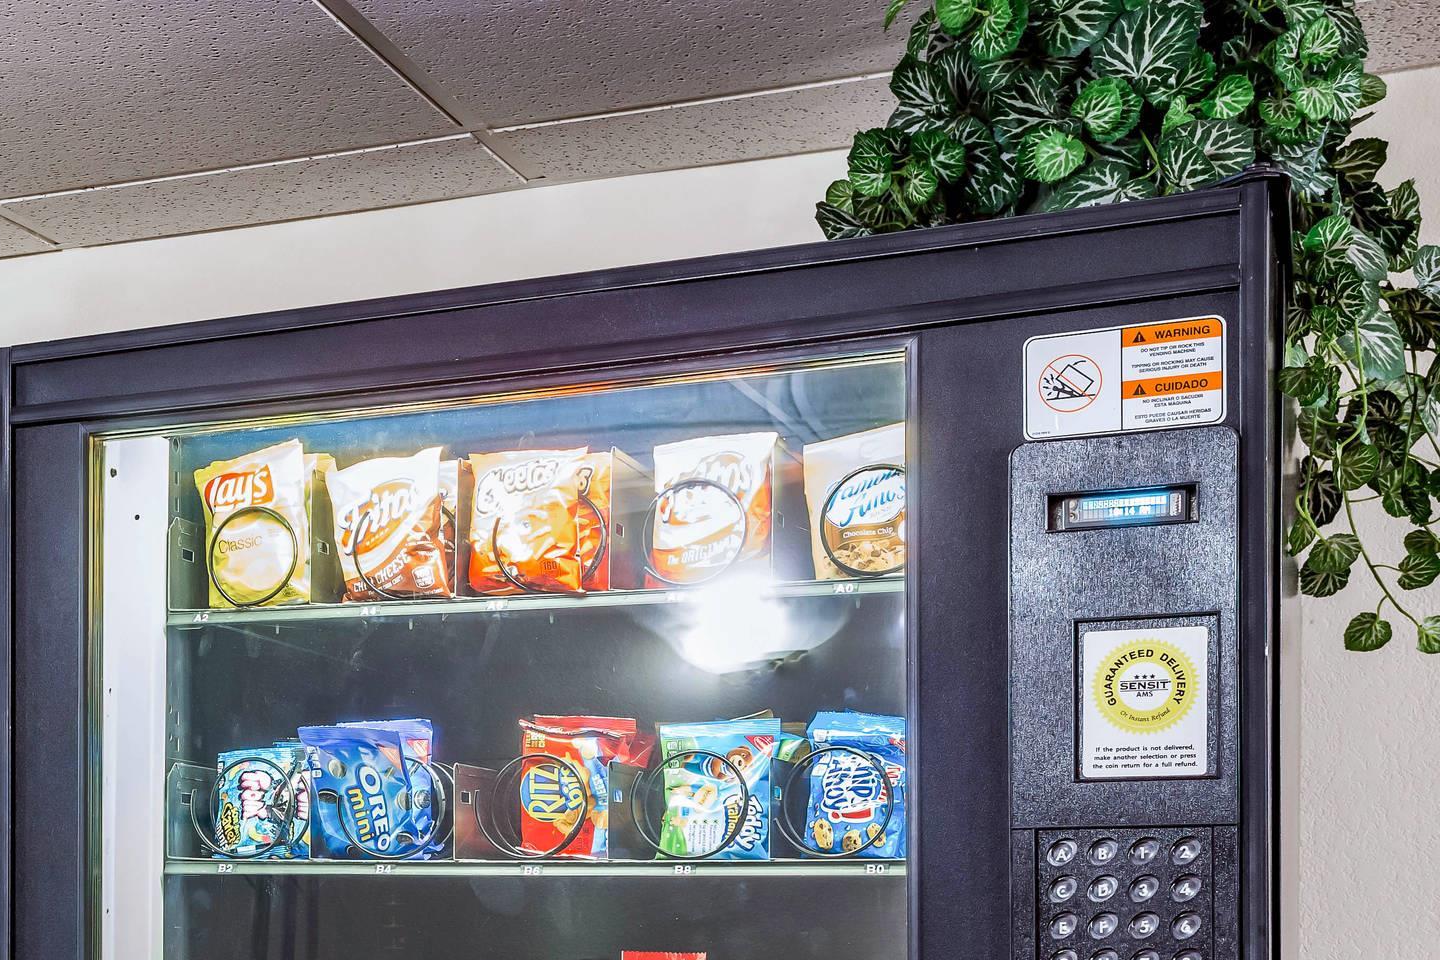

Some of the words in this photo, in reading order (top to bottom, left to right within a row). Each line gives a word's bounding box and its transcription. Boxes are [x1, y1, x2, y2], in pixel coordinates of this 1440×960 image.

[1155, 326, 1210, 339] WARNING
[1155, 379, 1208, 392] CUIDADO
[210, 467, 269, 509] Lay's
[843, 529, 877, 539] Chocolate
[877, 526, 894, 536] Chip
[218, 535, 263, 555] Classic
[194, 614, 209, 622] A2
[1103, 649, 1154, 706] GUARANTEED
[1159, 652, 1186, 705] DELIVERY
[1119, 681, 1168, 690] SENSIT
[528, 767, 565, 819] RITZ
[561, 766, 583, 809] bits
[348, 786, 373, 843] mini
[358, 765, 391, 852] OREO
[740, 794, 763, 852] Teddy
[1056, 849, 1066, 861] A
[1098, 848, 1107, 860] B
[1139, 847, 1146, 859] 1
[1179, 846, 1190, 859] 2
[218, 864, 233, 873] B2
[376, 865, 392, 874] B4
[524, 867, 540, 875] B6
[674, 865, 691, 874] B8
[866, 865, 885, 874] B0
[1057, 886, 1068, 898] C
[1098, 884, 1108, 896] D
[1139, 885, 1148, 897] 3
[1179, 883, 1190, 896] 4
[1060, 922, 1067, 935] E
[1099, 921, 1107, 933] F
[1140, 921, 1149, 933] 5
[1181, 920, 1190, 933] 6
